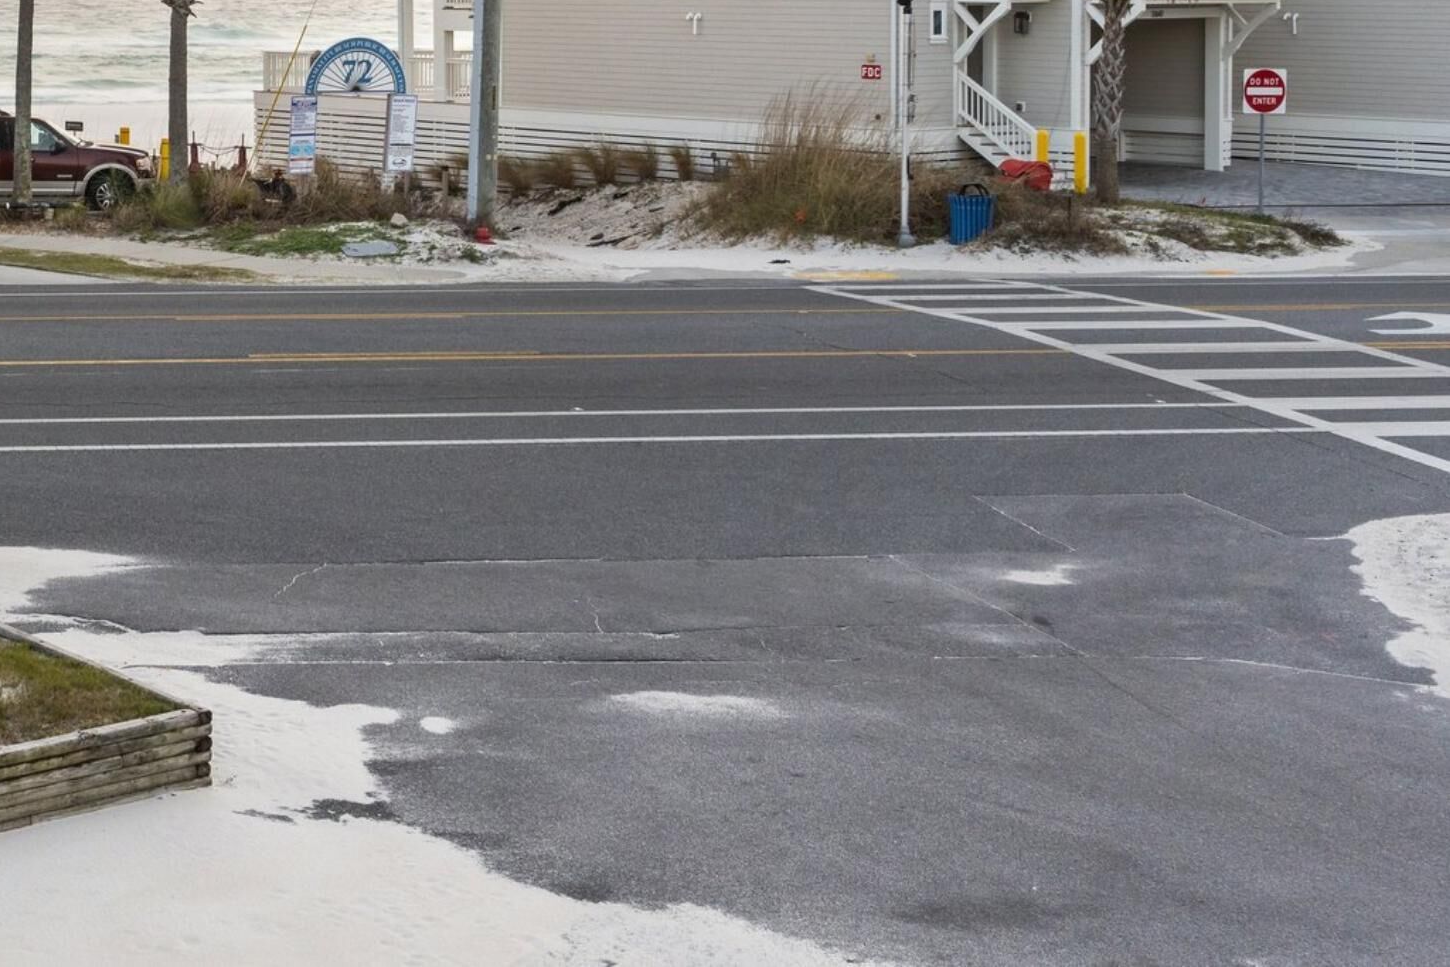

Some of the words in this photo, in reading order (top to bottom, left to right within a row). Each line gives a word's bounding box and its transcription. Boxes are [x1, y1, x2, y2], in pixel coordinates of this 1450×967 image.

[343, 59, 372, 83] 72
[861, 67, 880, 77] FDC
[1250, 77, 1261, 85] DO
[1263, 77, 1279, 85] NOT
[1252, 97, 1277, 105] ENTER
